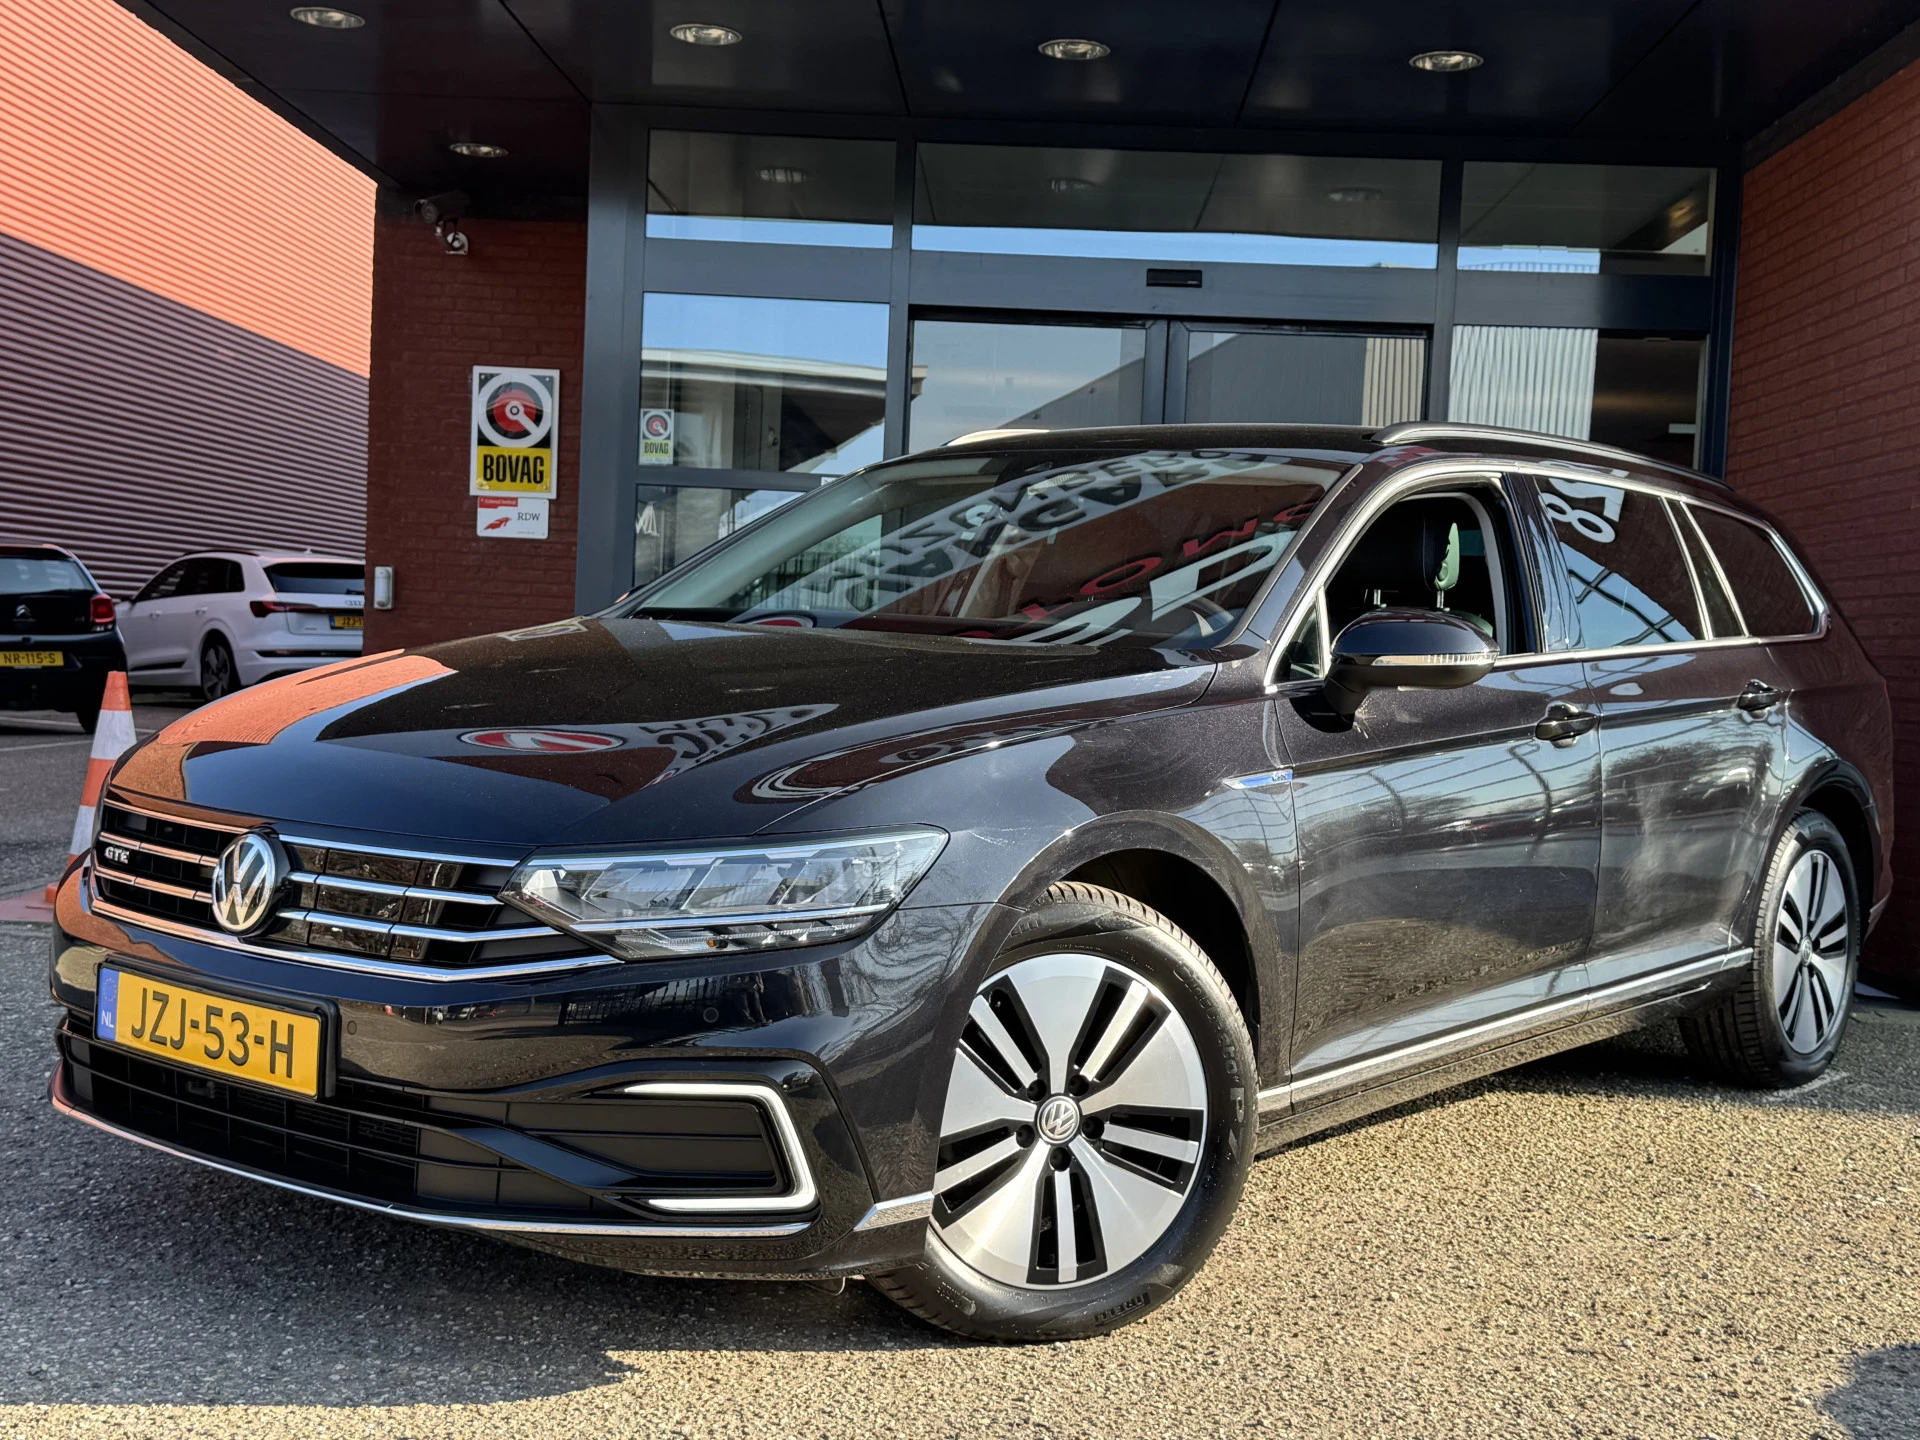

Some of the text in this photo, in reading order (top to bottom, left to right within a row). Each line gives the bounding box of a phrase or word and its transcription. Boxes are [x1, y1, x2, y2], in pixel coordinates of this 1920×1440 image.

[644, 442, 669, 455] BOVAG
[483, 454, 544, 484] BOVAG
[517, 512, 540, 521] RDW
[3, 652, 56, 664] NR-115-S
[104, 846, 130, 864] GTE
[101, 1010, 115, 1029] NL
[131, 987, 294, 1079] JZJ-53-H
